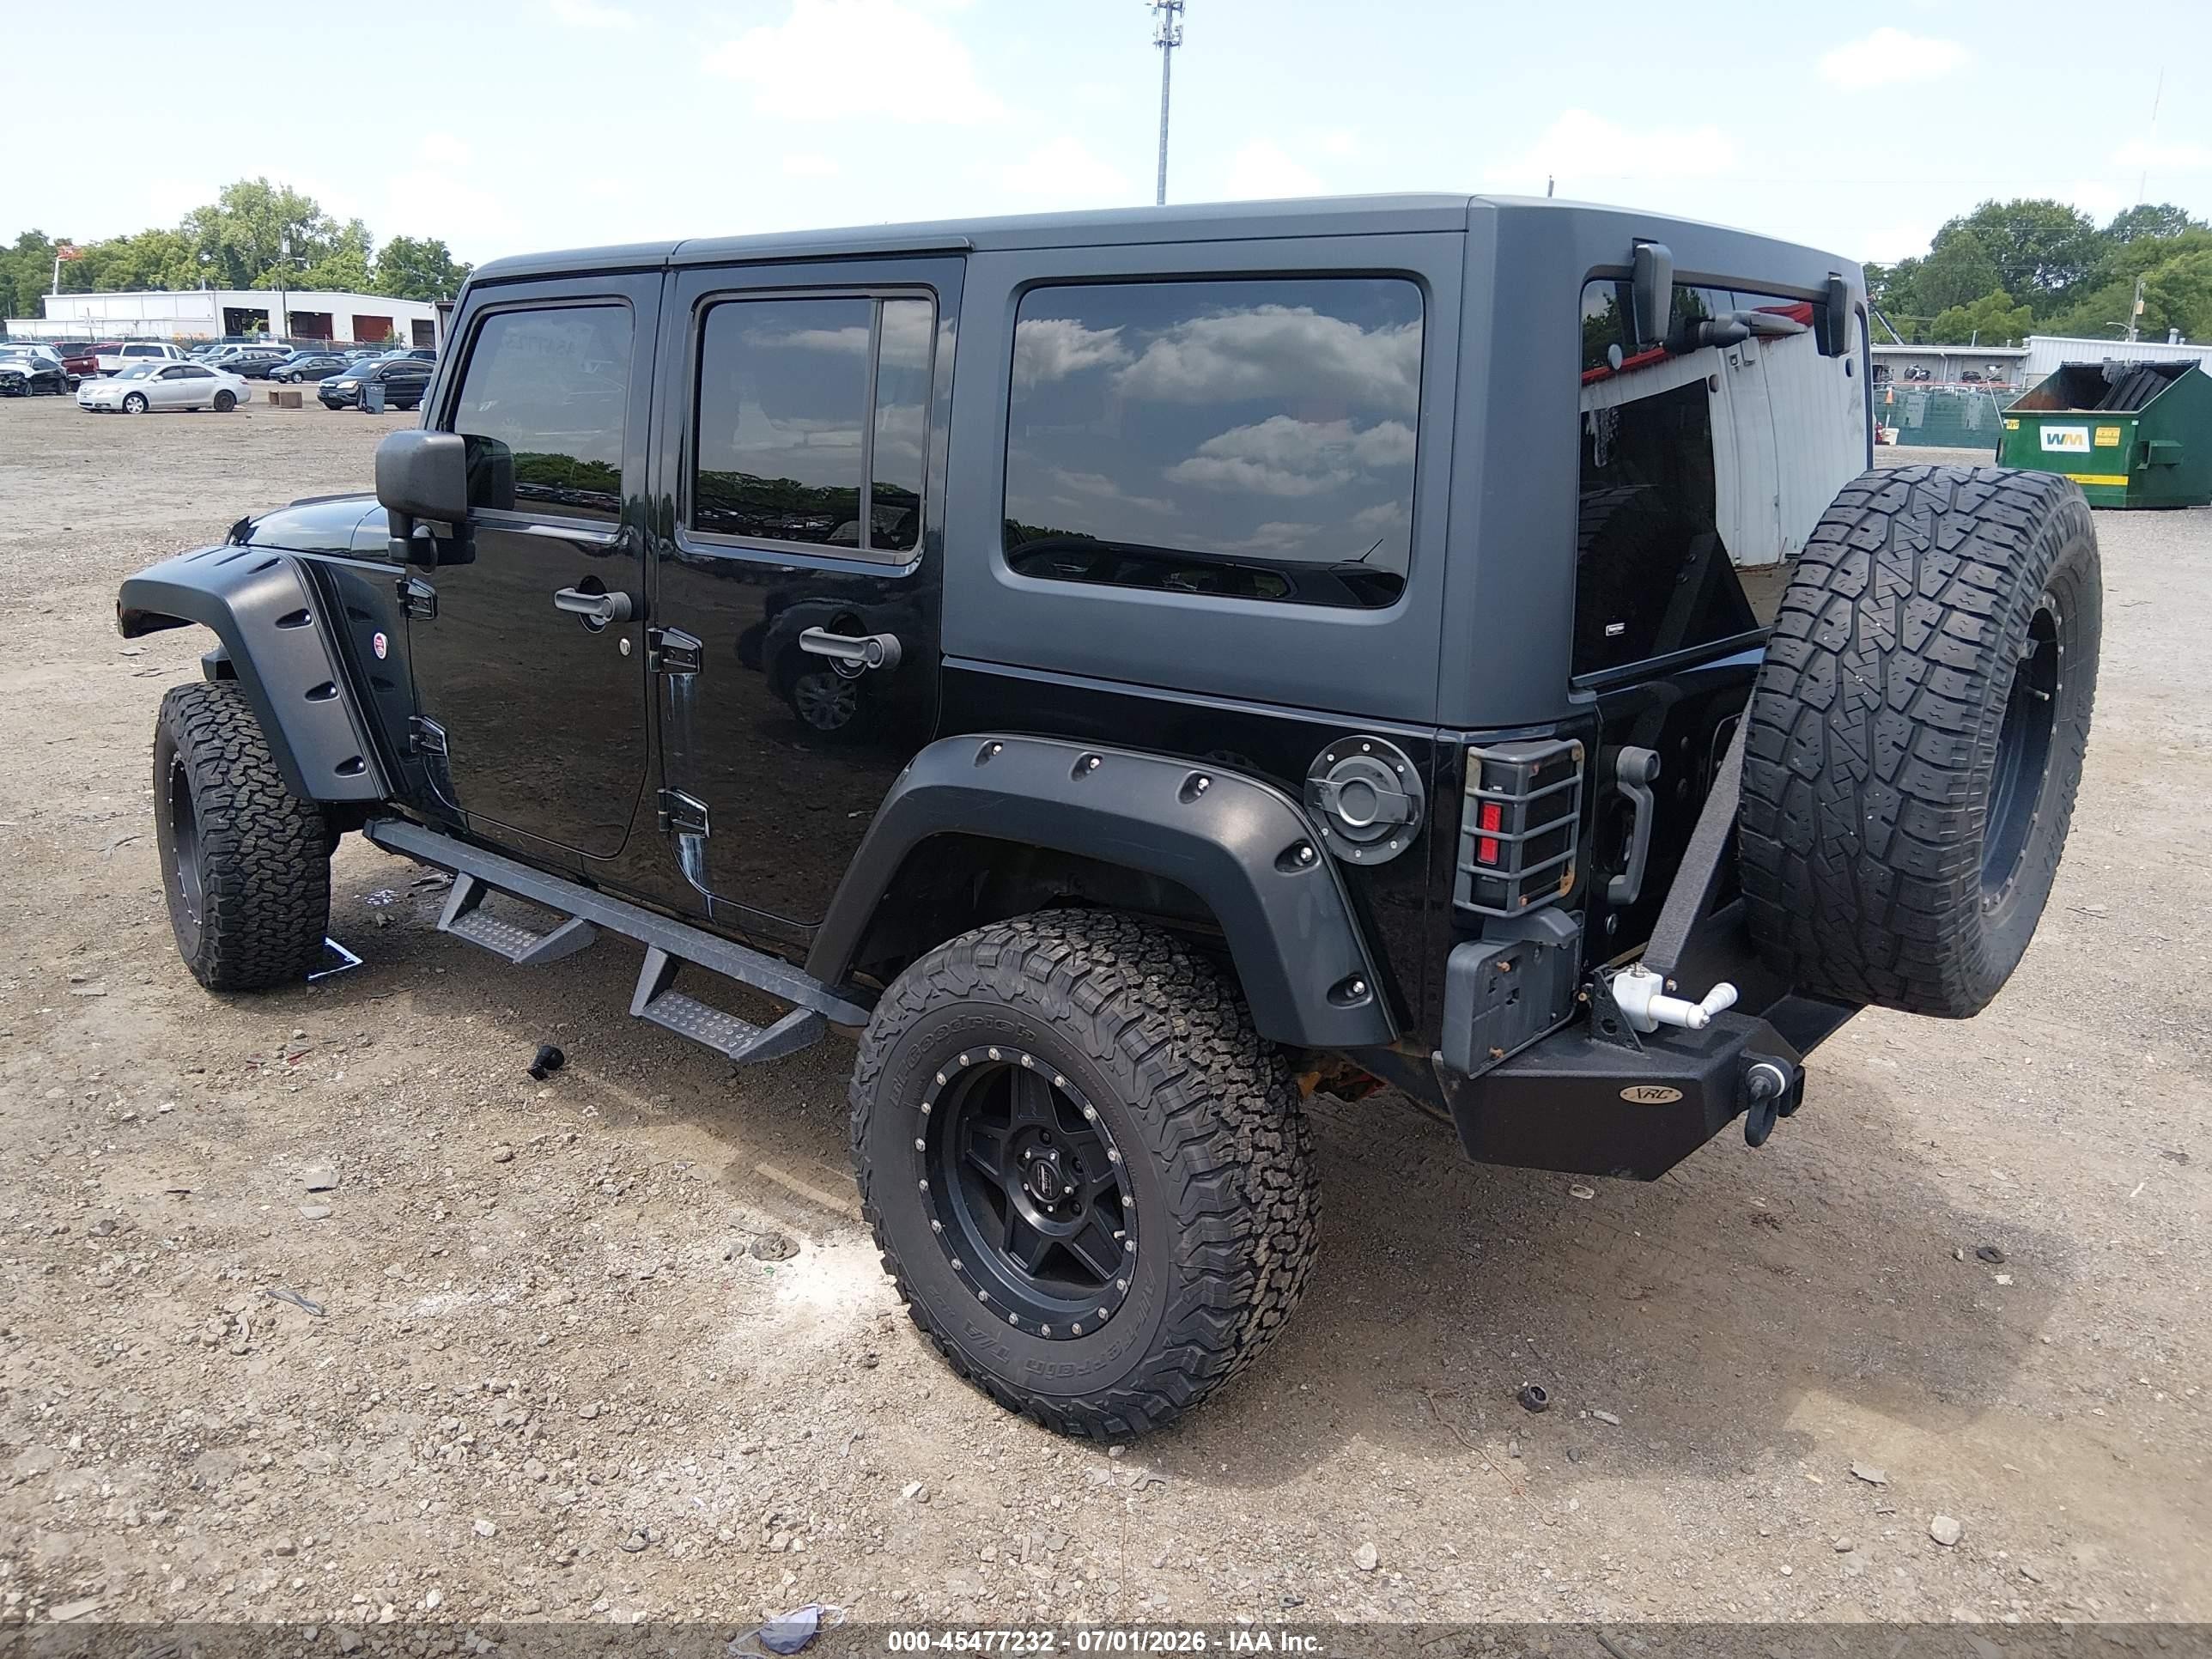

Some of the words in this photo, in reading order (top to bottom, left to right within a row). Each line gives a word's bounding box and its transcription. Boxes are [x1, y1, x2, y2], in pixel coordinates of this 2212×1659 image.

[2047, 434, 2083, 445] WM
[890, 1014, 1037, 1108] BFGoodrich
[1635, 1088, 1673, 1099] XRC
